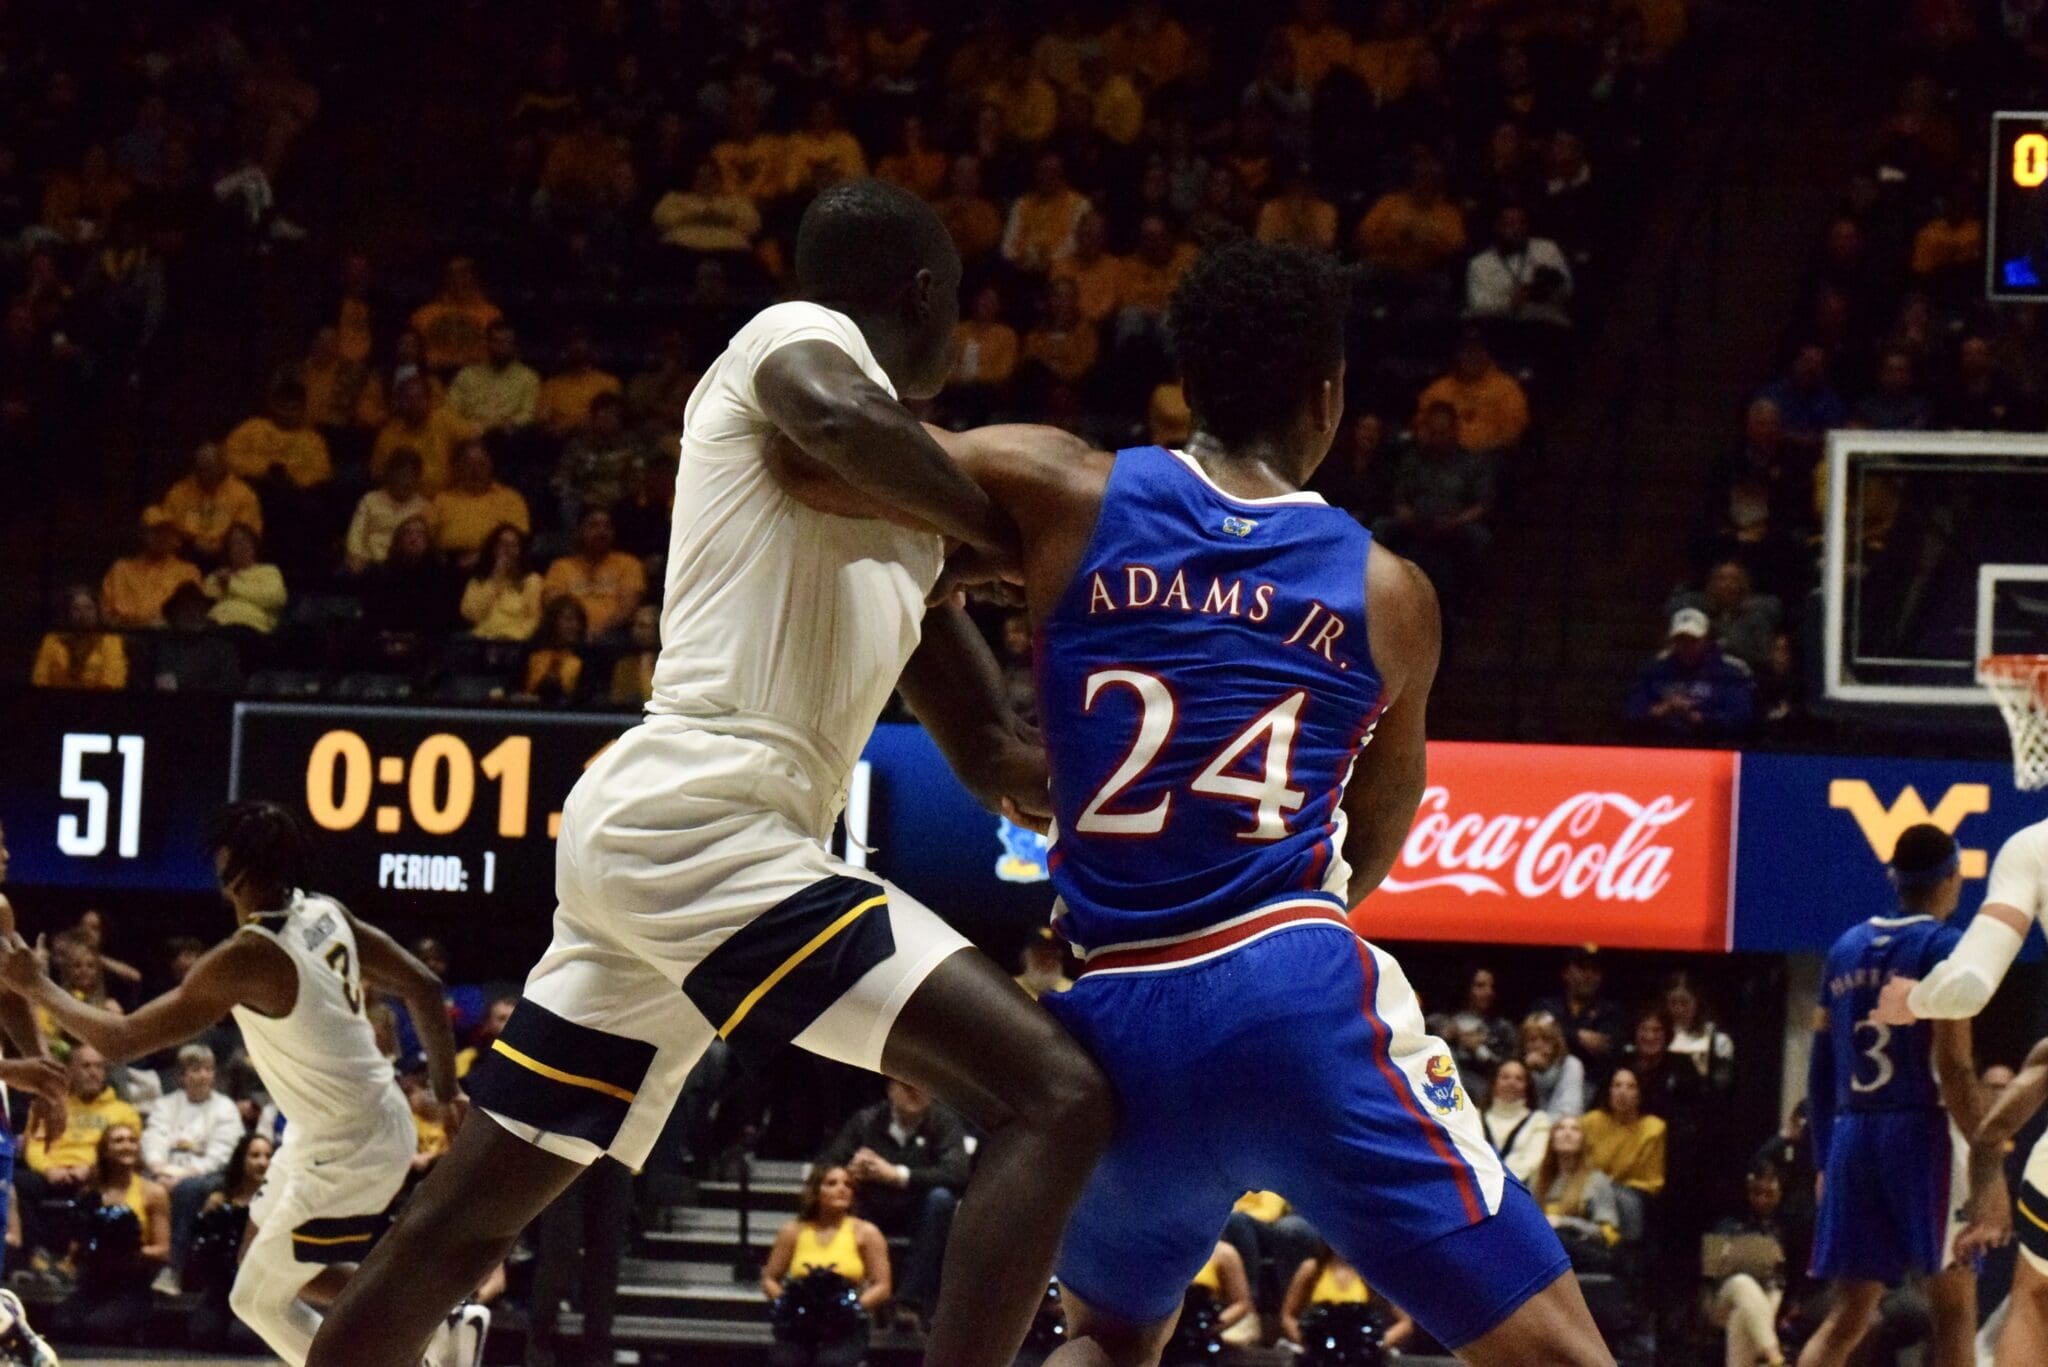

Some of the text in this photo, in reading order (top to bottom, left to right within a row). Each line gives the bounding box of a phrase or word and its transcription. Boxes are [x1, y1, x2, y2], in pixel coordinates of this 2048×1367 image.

[1087, 566, 1350, 671] ADAMS JR.
[57, 731, 146, 860] 51
[1074, 668, 1307, 841] 24
[377, 849, 497, 895] PERIOD: 1
[1850, 1018, 1894, 1093] 3
